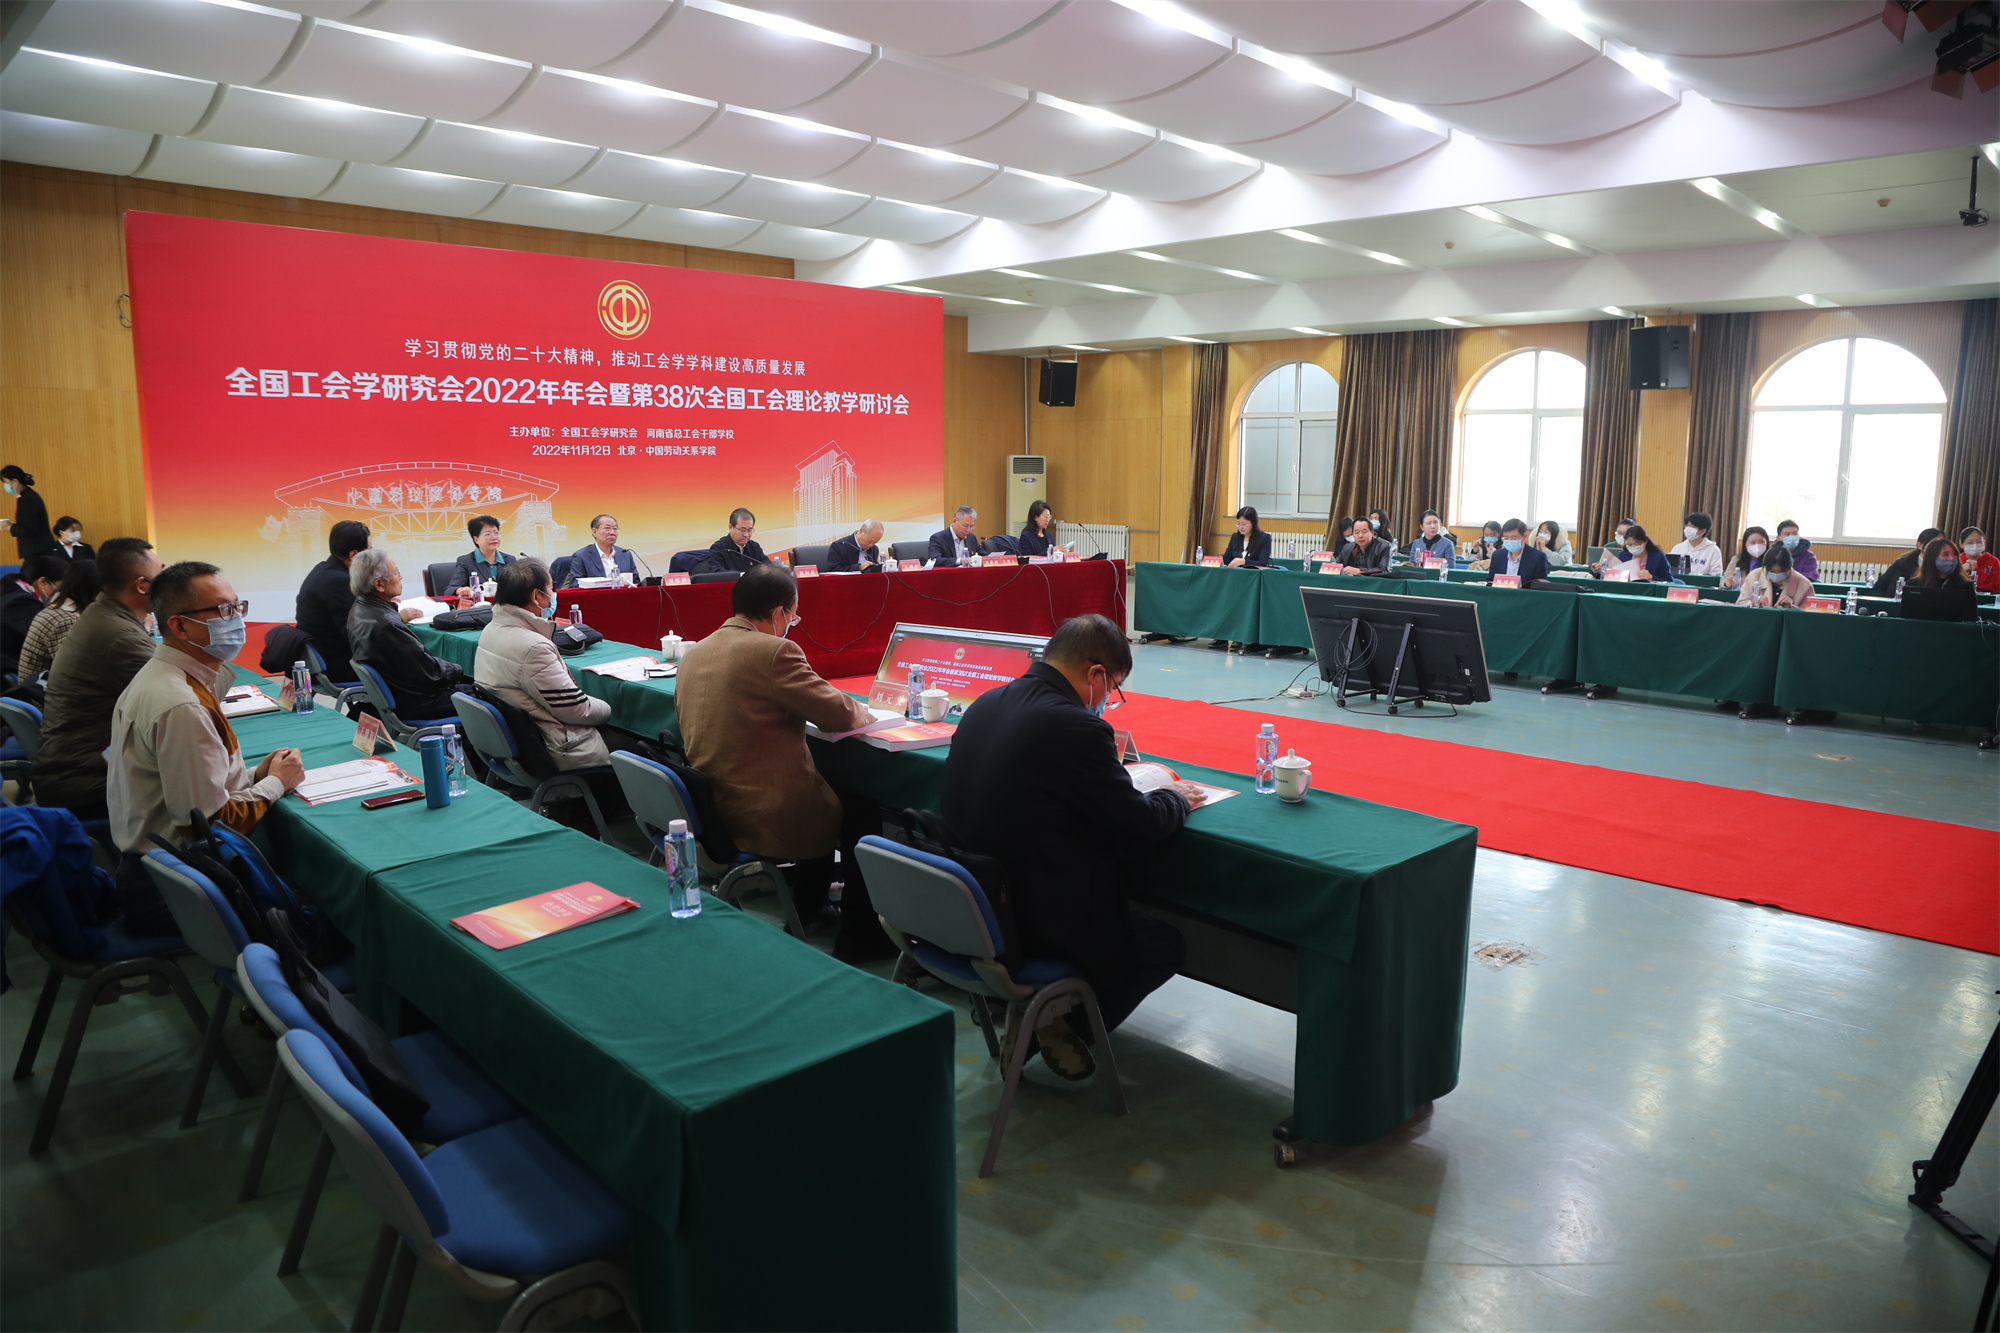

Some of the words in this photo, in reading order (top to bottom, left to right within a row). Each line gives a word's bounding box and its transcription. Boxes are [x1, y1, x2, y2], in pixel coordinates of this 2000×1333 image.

[404, 338, 806, 376] 学习贯彻党的二十大精神，推动工会学学科建设高质量发展
[225, 366, 910, 415] 全国工会学研究会2022年年会暨第38次全国工会理论教学研讨会
[646, 427, 735, 440] 河南省总工会干部学校
[532, 445, 611, 457] 2022年11月12日
